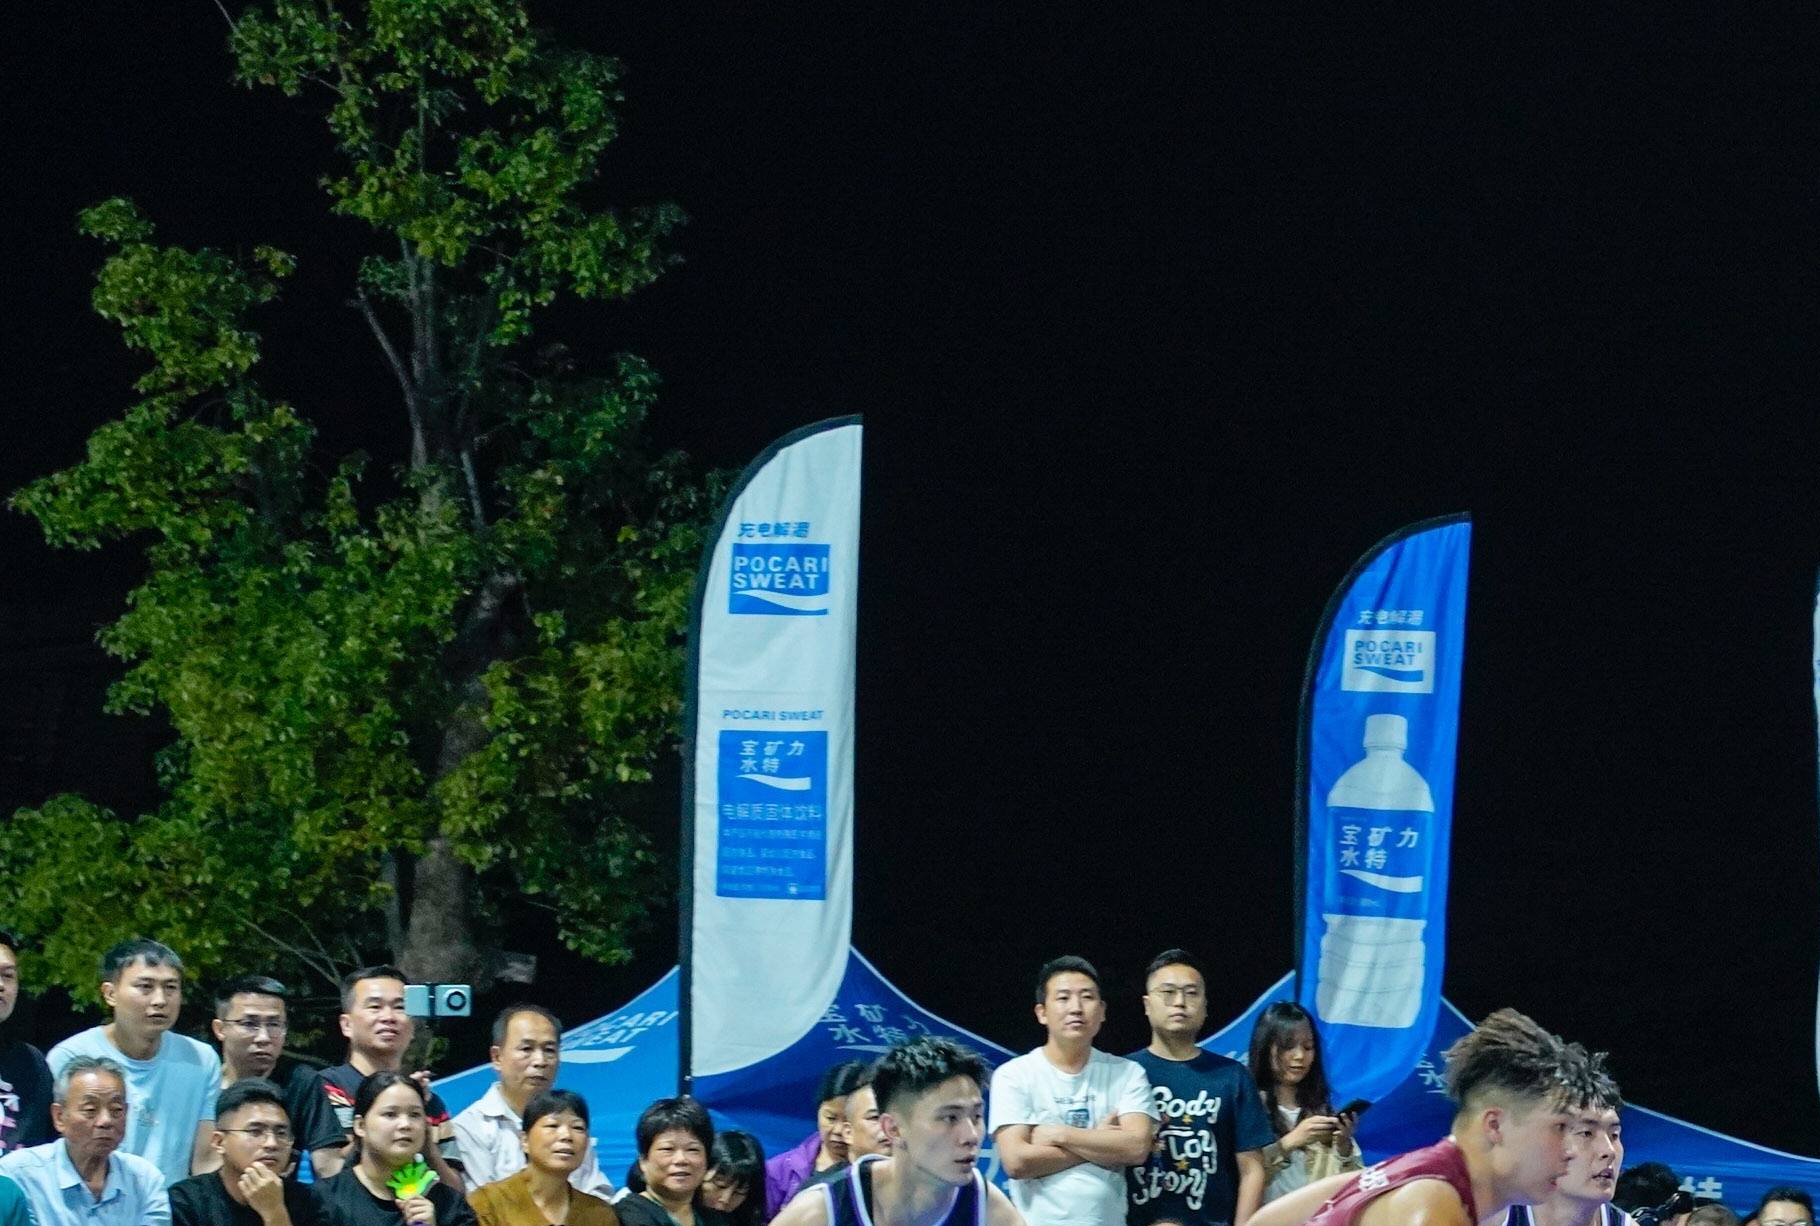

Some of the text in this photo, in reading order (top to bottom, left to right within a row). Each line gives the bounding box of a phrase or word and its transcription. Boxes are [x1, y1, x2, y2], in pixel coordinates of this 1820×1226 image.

[733, 555, 828, 573] POCARI
[732, 572, 820, 590] SWEAT
[1354, 640, 1424, 654] POCARI
[1353, 652, 1415, 666] SWEAT
[722, 709, 824, 721] POCARI SWEAT
[739, 740, 806, 756] 宝矿力
[739, 756, 780, 773] 水特
[1339, 824, 1420, 849] 宝矿力
[1339, 846, 1388, 870] 水特
[1132, 1166, 1208, 1211] Story
